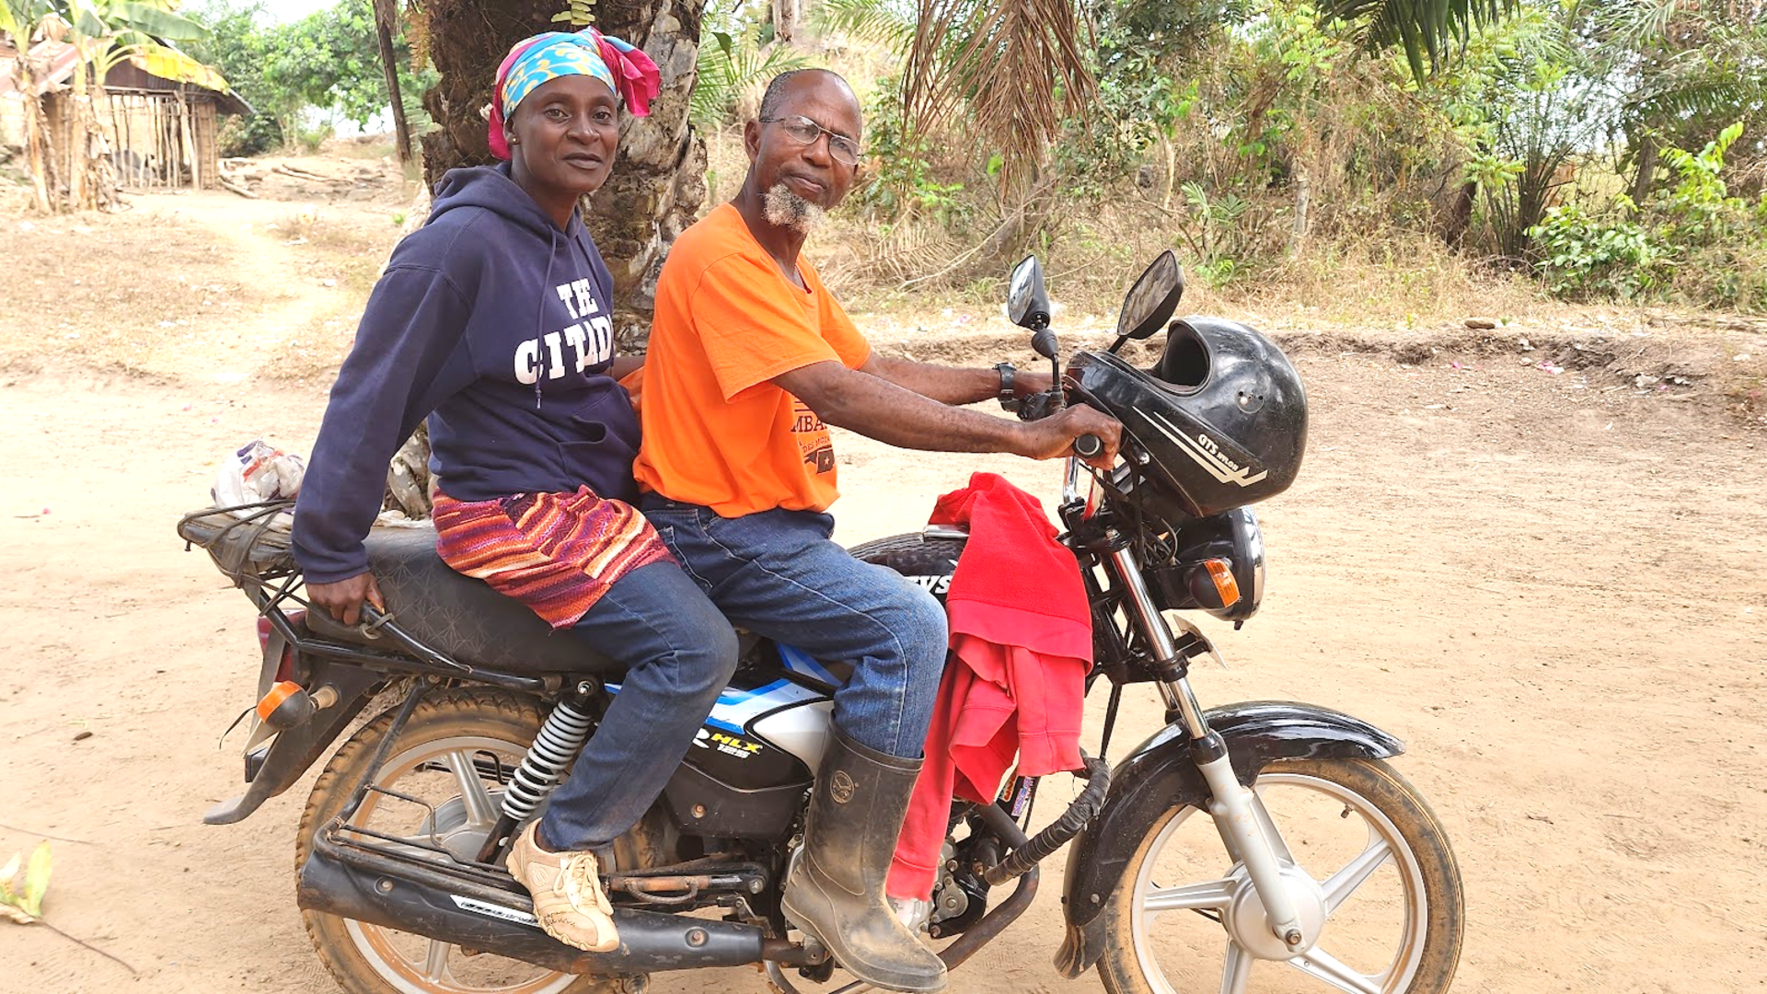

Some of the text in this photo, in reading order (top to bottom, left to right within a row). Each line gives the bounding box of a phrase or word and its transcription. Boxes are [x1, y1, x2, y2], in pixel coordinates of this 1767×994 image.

[556, 278, 599, 319] THE
[514, 314, 614, 385] CITAD
[790, 415, 828, 433] MBA
[1198, 433, 1219, 455] GTS
[711, 732, 763, 755] HLX
